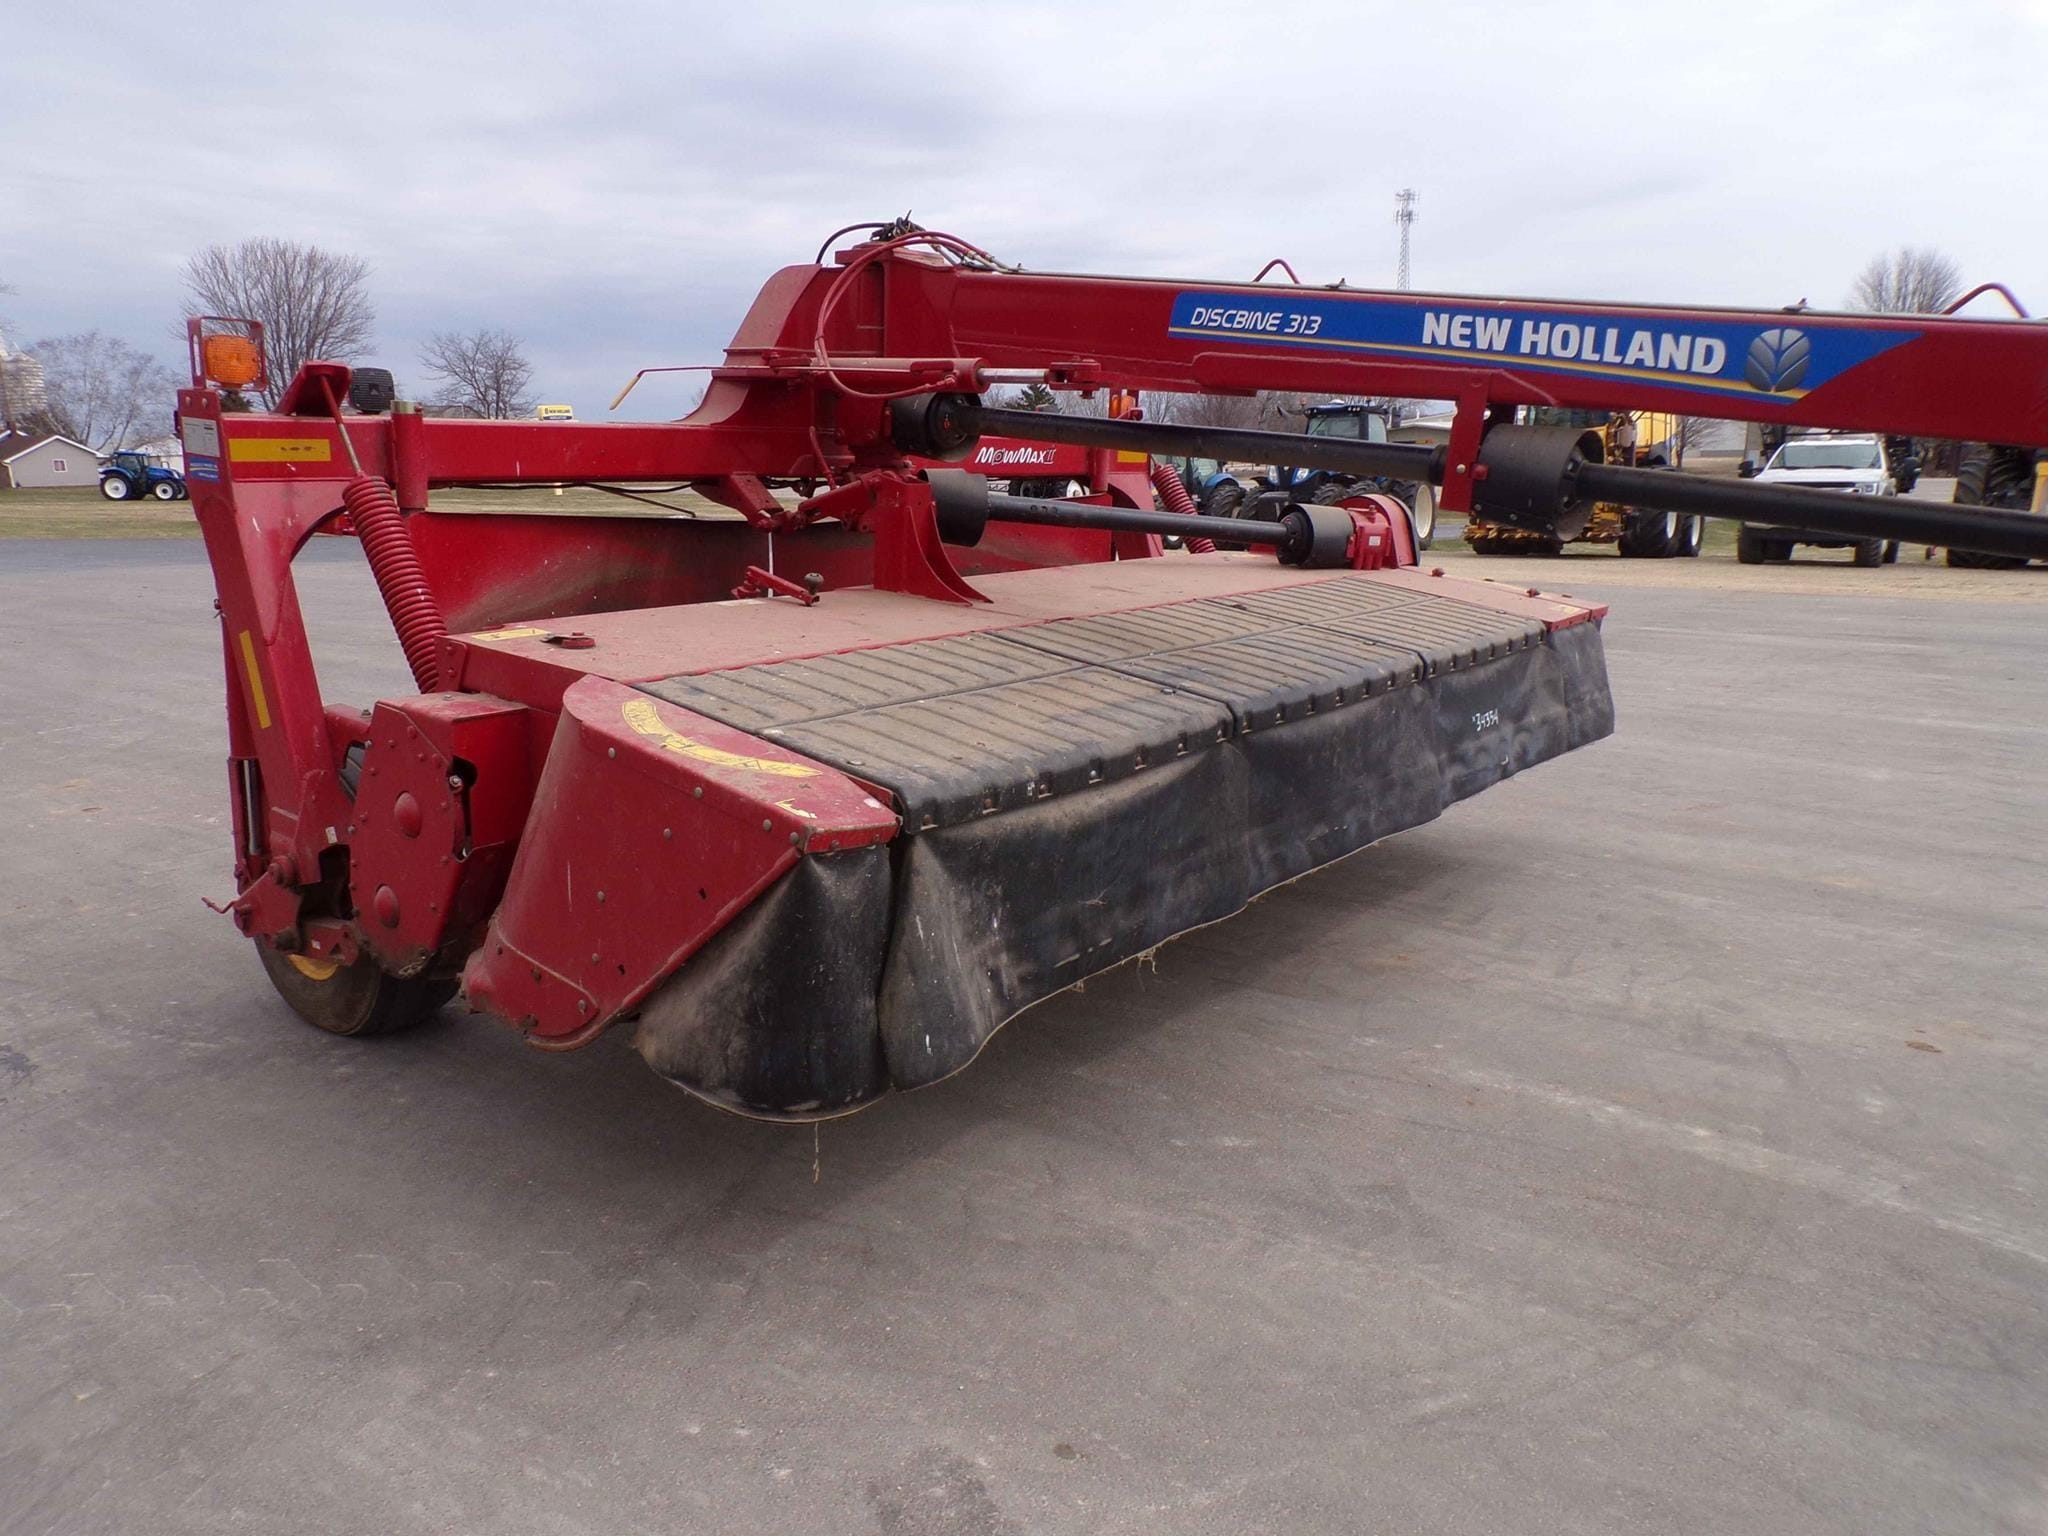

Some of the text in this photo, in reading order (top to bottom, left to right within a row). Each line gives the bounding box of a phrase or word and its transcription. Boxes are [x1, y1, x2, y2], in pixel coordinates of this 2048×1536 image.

[1190, 307, 1322, 335] DISCBINE 313
[1422, 312, 1726, 375] NEW HOLLAND
